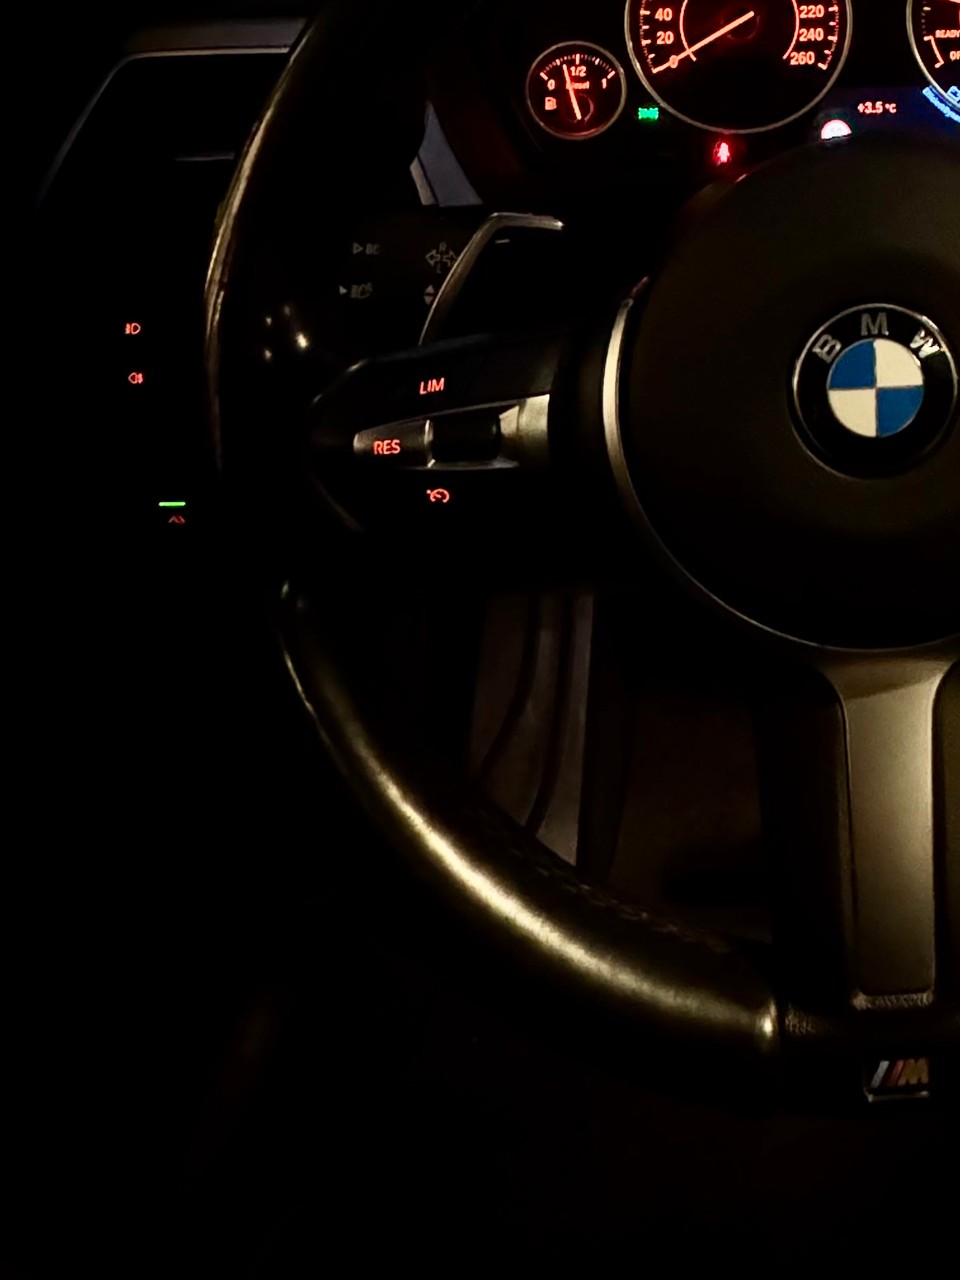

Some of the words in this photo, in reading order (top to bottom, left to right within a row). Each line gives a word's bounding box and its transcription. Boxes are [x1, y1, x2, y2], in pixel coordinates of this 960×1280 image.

[655, 7, 673, 21] 40
[799, 5, 824, 19] 220
[656, 31, 674, 45] 20
[799, 28, 824, 42] 240
[935, 30, 960, 38] READY
[790, 51, 815, 65] 260
[570, 65, 587, 77] 1/2
[547, 79, 555, 90] 0
[601, 78, 607, 89] 1
[857, 101, 883, 114] +3.5
[812, 312, 942, 364] BMW
[419, 377, 445, 395] LIM
[373, 439, 401, 455] RES
